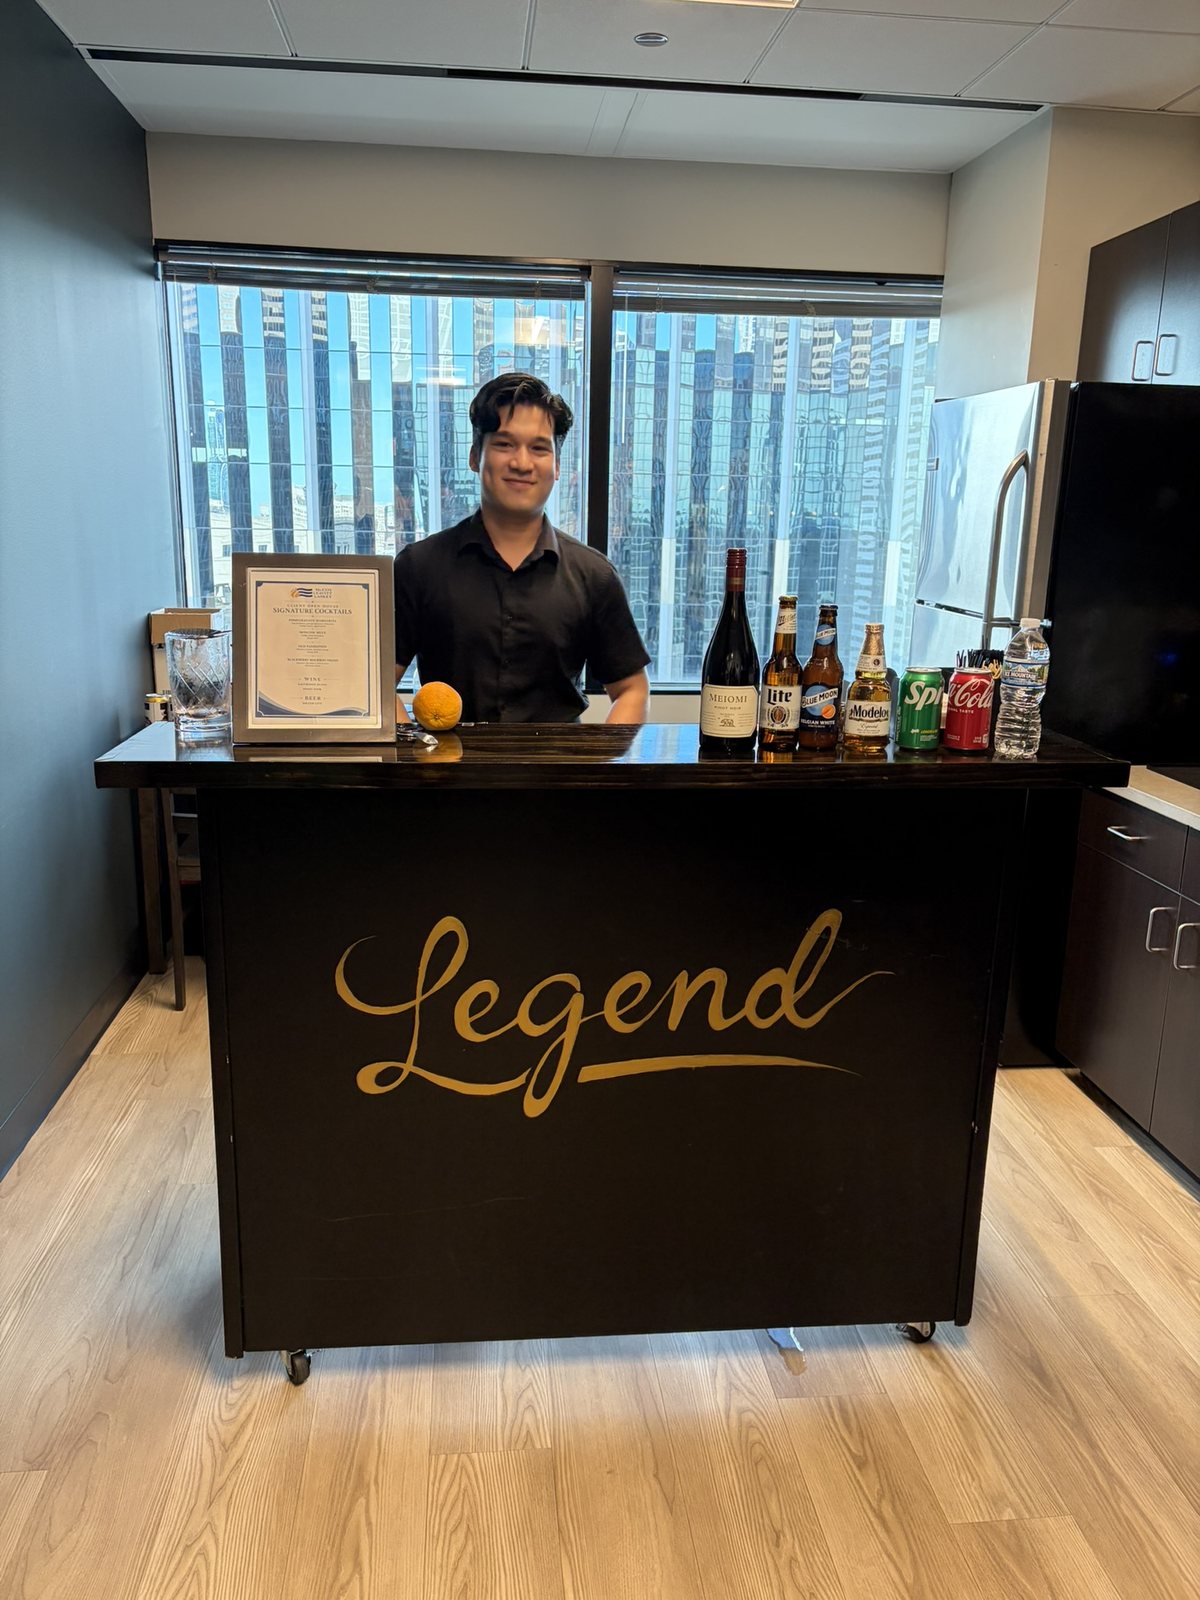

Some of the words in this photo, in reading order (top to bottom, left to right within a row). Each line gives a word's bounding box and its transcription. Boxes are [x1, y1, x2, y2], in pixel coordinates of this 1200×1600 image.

[273, 607, 313, 615] SIGNATURE
[709, 693, 747, 703] MEIOMI
[767, 688, 792, 706] Lite
[802, 696, 818, 707] BLUE
[818, 689, 838, 701] MOON
[853, 704, 887, 719] Modelo
[335, 908, 895, 1118] Legend
